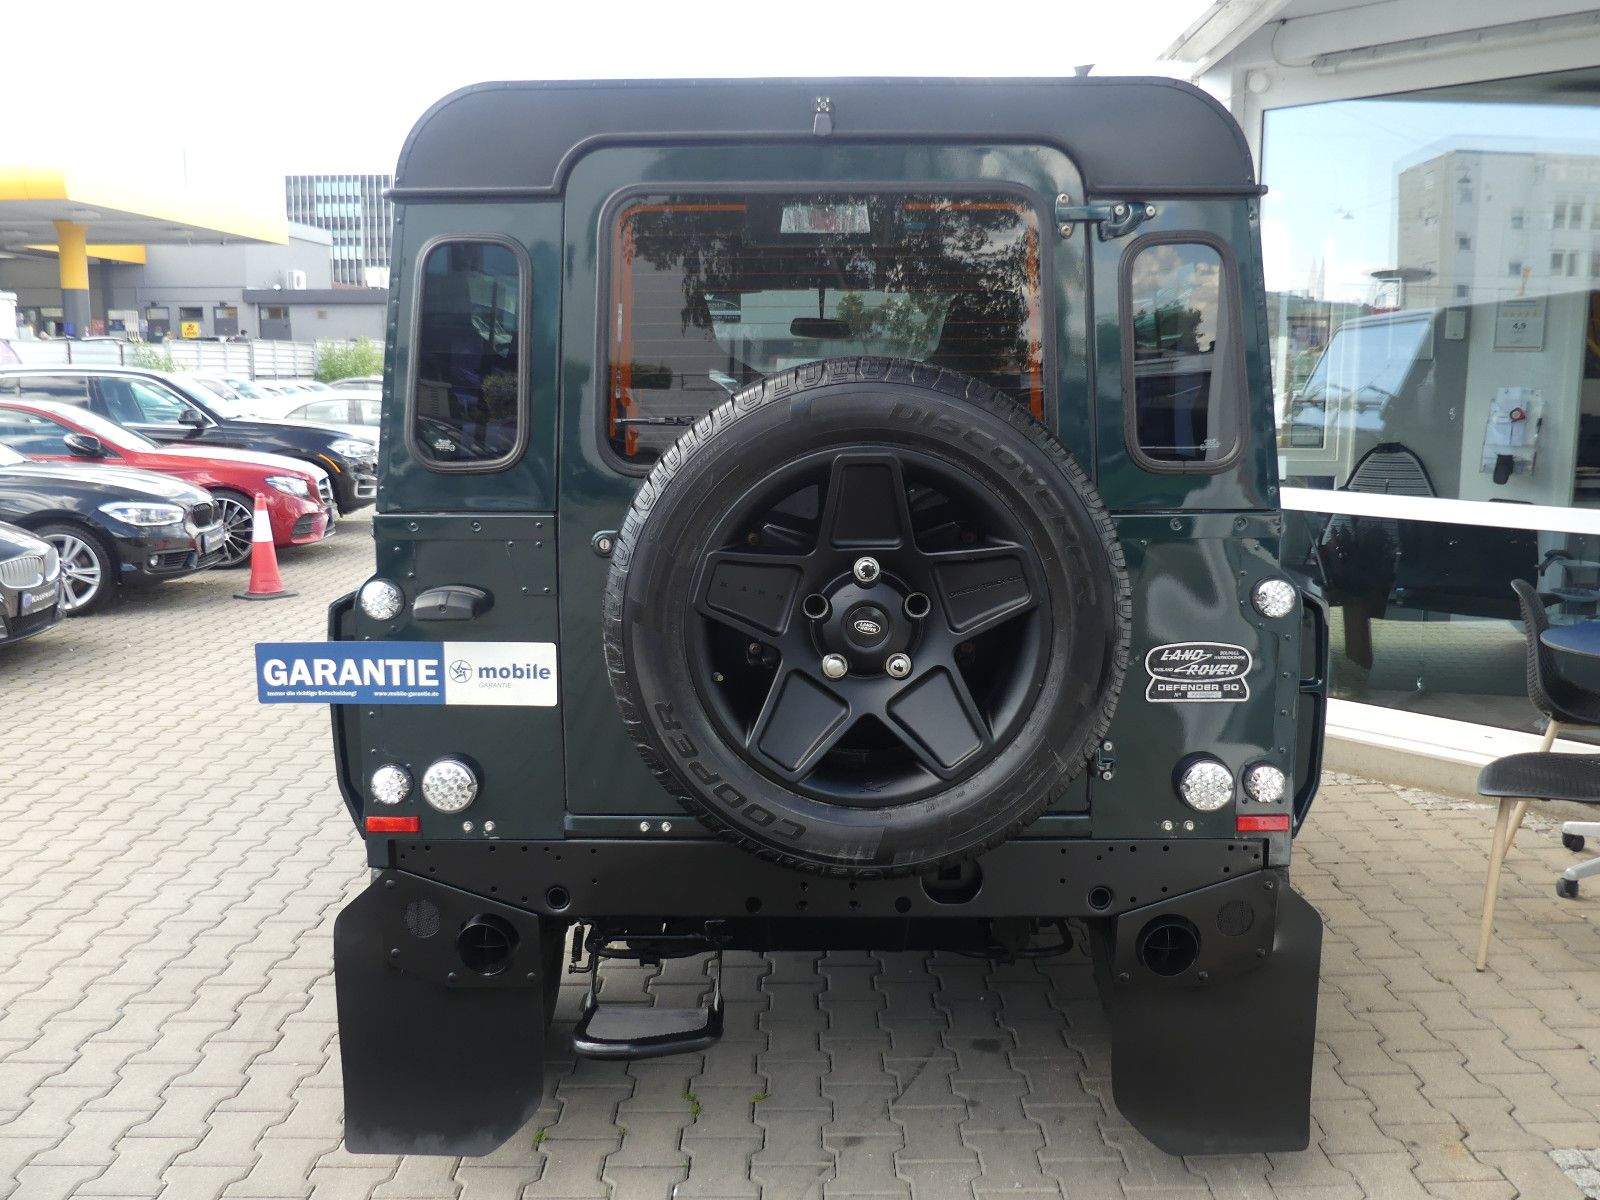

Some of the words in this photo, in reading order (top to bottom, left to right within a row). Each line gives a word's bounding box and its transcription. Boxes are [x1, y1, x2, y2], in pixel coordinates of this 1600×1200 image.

[1160, 649, 1204, 661] LAND
[262, 658, 440, 687] GARANTIE
[478, 663, 552, 680] mobile
[1185, 664, 1239, 676] ROVER
[478, 681, 512, 689] GARANTIE
[1223, 683, 1240, 691] 90
[654, 699, 807, 841] COOPER
